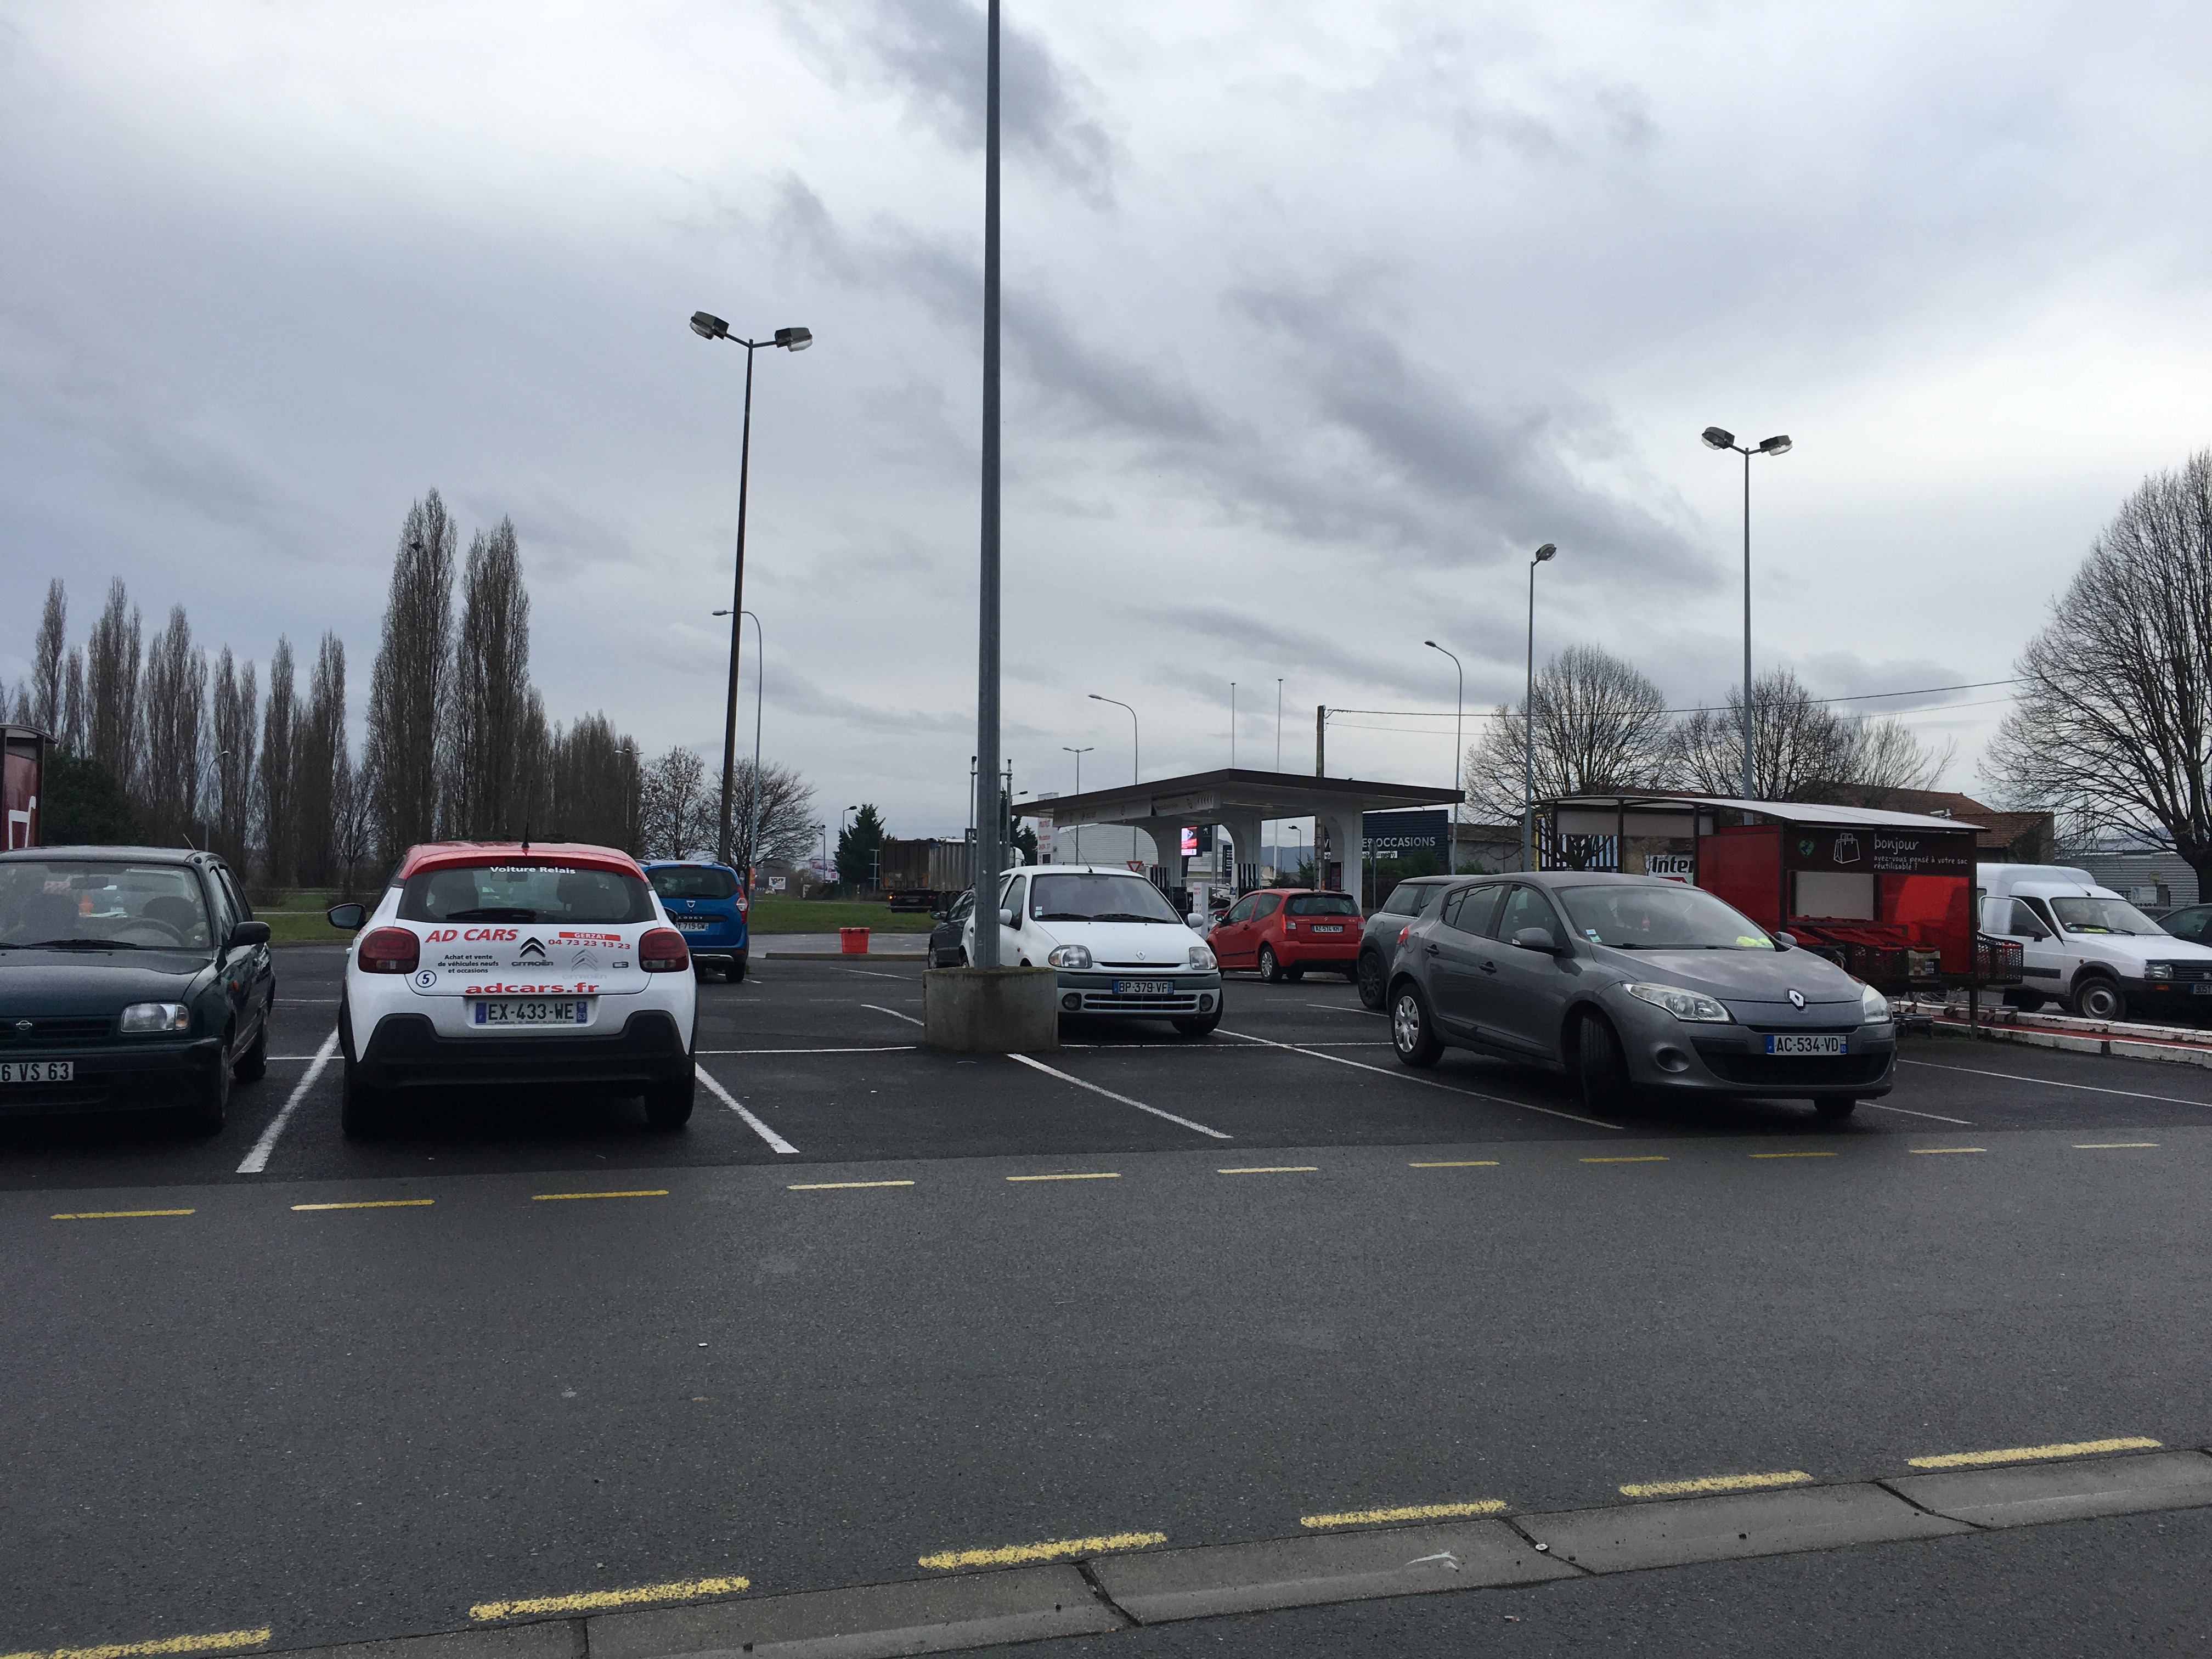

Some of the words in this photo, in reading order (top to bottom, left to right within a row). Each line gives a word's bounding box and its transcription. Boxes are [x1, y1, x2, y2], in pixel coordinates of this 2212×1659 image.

[1376, 837, 1435, 847] OCCASIONS
[1874, 833, 1919, 855] bonjour
[1874, 862, 1912, 870] réutilisable
[425, 930, 458, 943] AD
[464, 929, 518, 941] CARS
[422, 974, 430, 984] 5
[465, 983, 599, 994] adcars.fr
[488, 1003, 574, 1020] EX-433-WE
[1776, 1037, 1838, 1052] AC-534-VD
[19, 1064, 40, 1081] VS
[48, 1063, 69, 1080] 63
